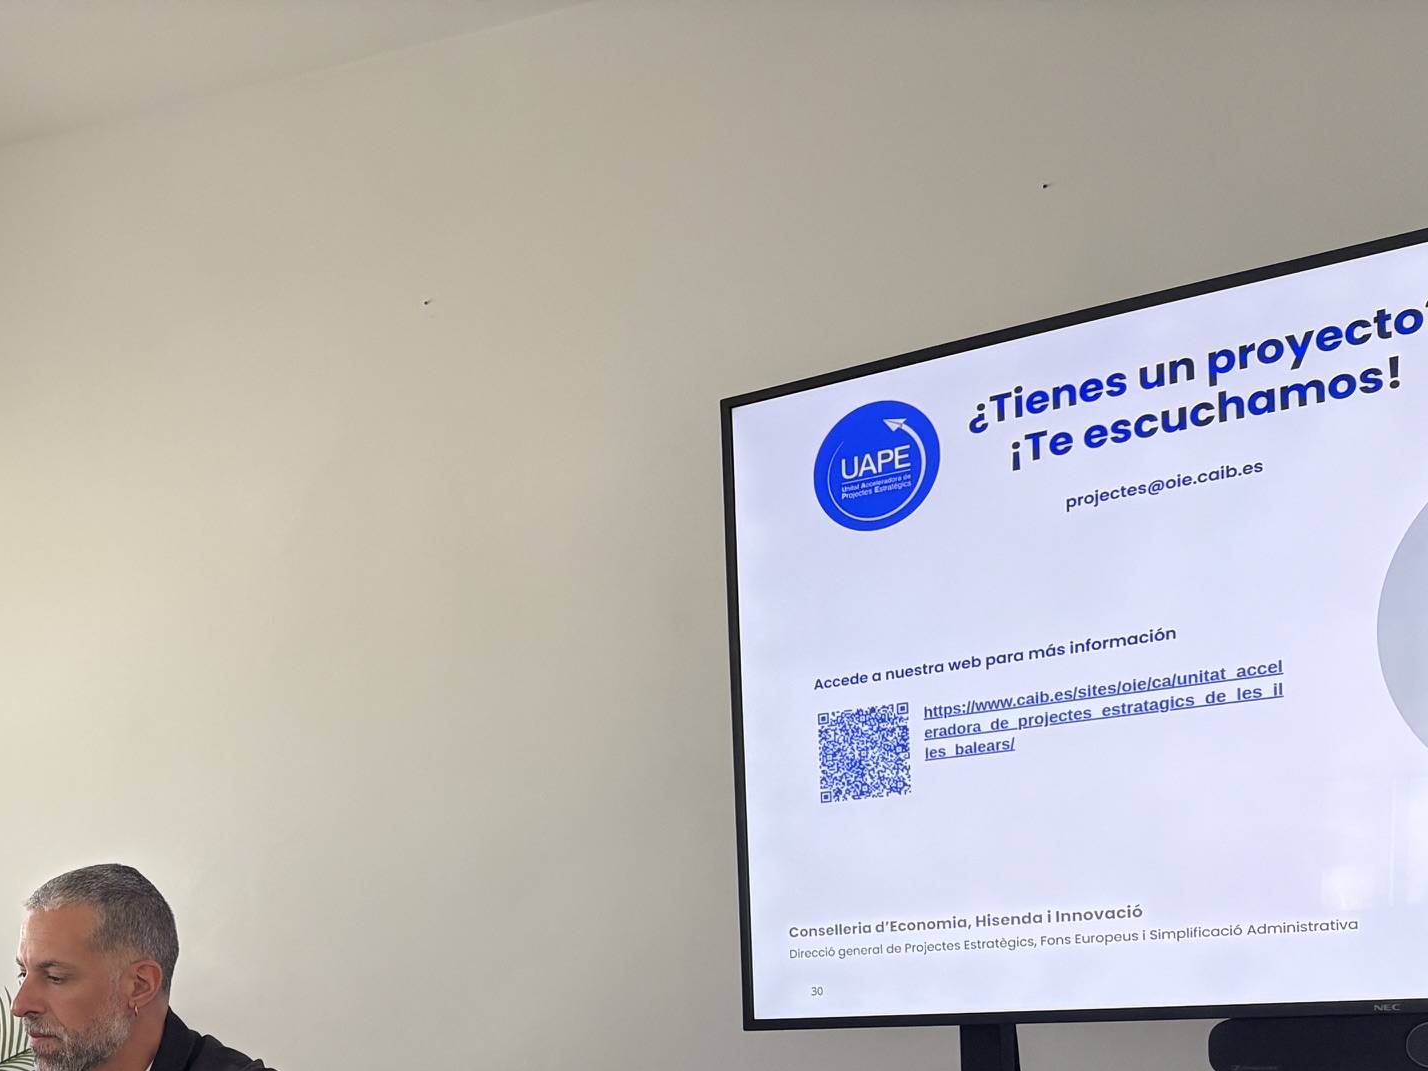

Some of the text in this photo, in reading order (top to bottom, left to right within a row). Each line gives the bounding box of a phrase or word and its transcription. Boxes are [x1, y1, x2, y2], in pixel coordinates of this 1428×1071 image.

[968, 301, 1428, 434] ¿Tienes un proyecto
[1011, 355, 1401, 472] ¡Te escuchamos!
[841, 444, 912, 480] UAPE
[1065, 461, 1264, 513] projectes@oie.caib.es
[813, 627, 1177, 691] Accede a nuestra web para más información
[788, 923, 872, 938] Conselleria
[975, 911, 1043, 928] Hisenda
[1055, 903, 1143, 923] Innovació
[789, 946, 836, 959] Direcció
[838, 944, 884, 960] general
[886, 943, 902, 954] de
[904, 940, 961, 955] Projectes
[963, 936, 1038, 951] Estratègics,
[1040, 935, 1072, 946] Fons
[1074, 931, 1139, 946] Europeus
[1149, 925, 1244, 942] Simplificació
[1246, 918, 1359, 936] Administrativa
[810, 986, 824, 997] 30
[1373, 1003, 1401, 1012] NEC
